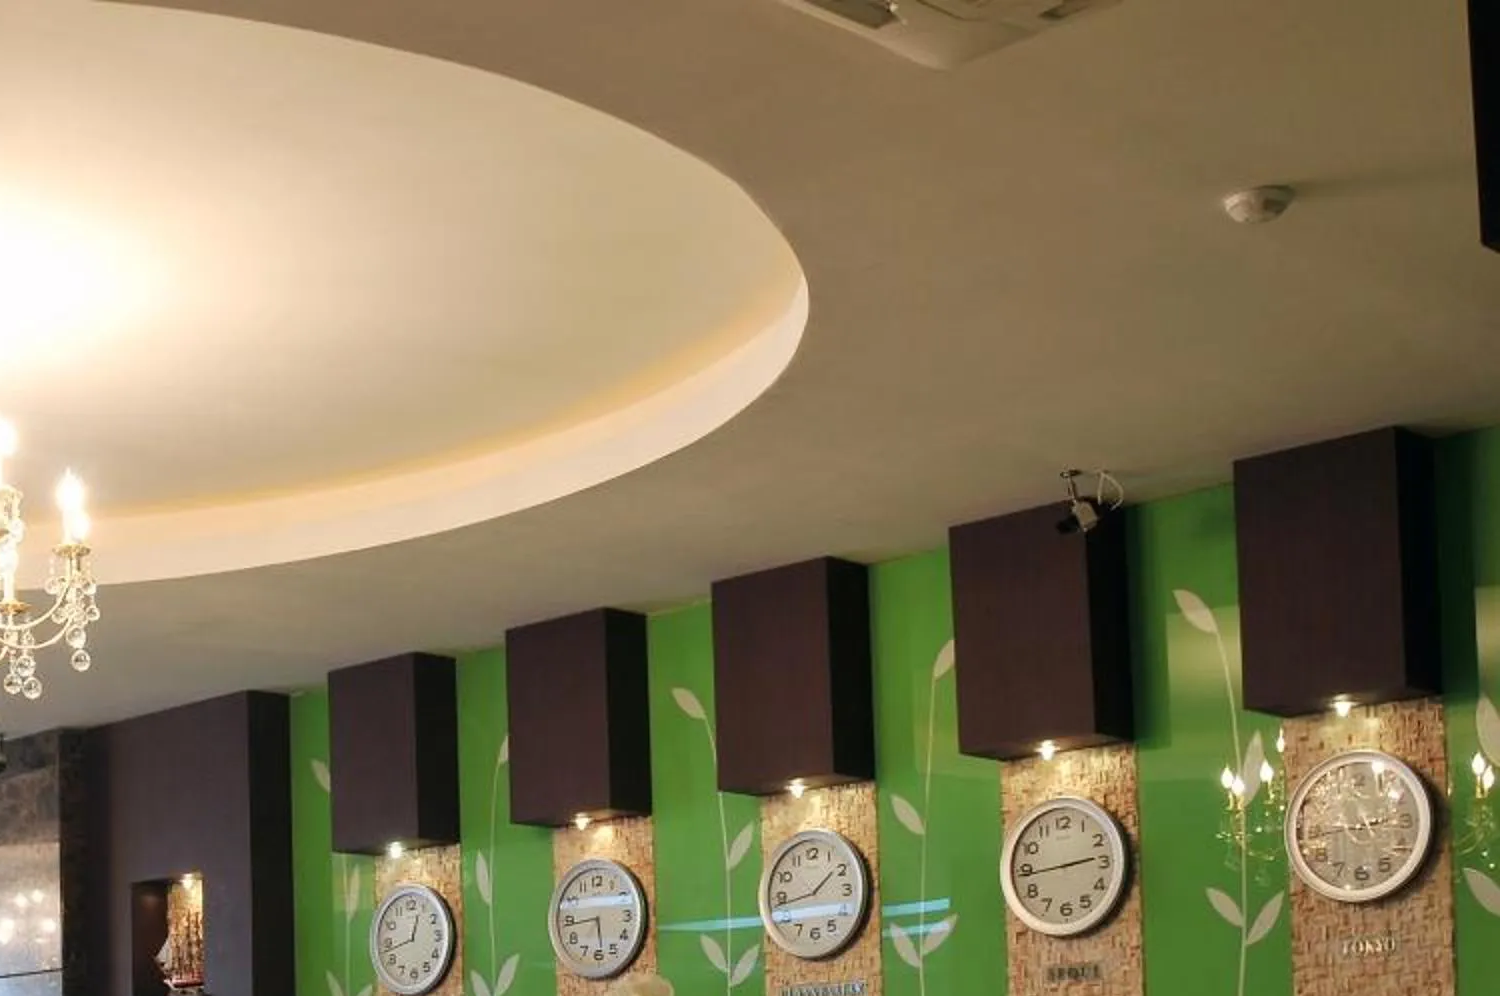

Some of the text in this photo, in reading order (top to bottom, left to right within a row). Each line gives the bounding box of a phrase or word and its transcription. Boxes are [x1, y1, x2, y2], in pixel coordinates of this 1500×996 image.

[1056, 816, 1071, 830] 12
[1401, 814, 1412, 828] 3
[1039, 825, 1049, 837] 11
[1093, 834, 1104, 847] 2
[806, 848, 819, 860] 12
[1024, 842, 1038, 855] 10
[792, 856, 800, 867] 11
[1099, 856, 1109, 869] 3
[1379, 858, 1391, 872] 5
[837, 864, 847, 876] 2
[1020, 863, 1032, 876] 9
[1333, 863, 1344, 877] 7
[592, 876, 602, 887] 12
[778, 871, 792, 883] 10
[580, 880, 586, 892] 11
[842, 884, 852, 896] 3
[1094, 878, 1105, 891] 4
[1027, 884, 1038, 898] 8
[777, 892, 787, 905] 9
[1042, 898, 1052, 911] 7
[1080, 895, 1092, 908] 5
[407, 900, 416, 910] 12
[1060, 902, 1072, 916] 6
[395, 907, 402, 917] 11
[624, 910, 632, 922] 3
[430, 914, 437, 924] 2
[564, 915, 574, 926] 9
[794, 924, 803, 937] 7
[827, 920, 836, 933] 5
[435, 931, 442, 942] 3
[570, 932, 578, 944] 8
[620, 928, 628, 940] 4
[810, 928, 820, 940] 6
[385, 937, 392, 949] 9
[609, 943, 618, 955] 5
[432, 948, 439, 958] 4
[580, 945, 588, 956] 7
[594, 950, 603, 961] 6
[389, 954, 396, 964] 8
[398, 965, 405, 975] 7
[423, 962, 430, 972] 5
[410, 969, 418, 979] 6
